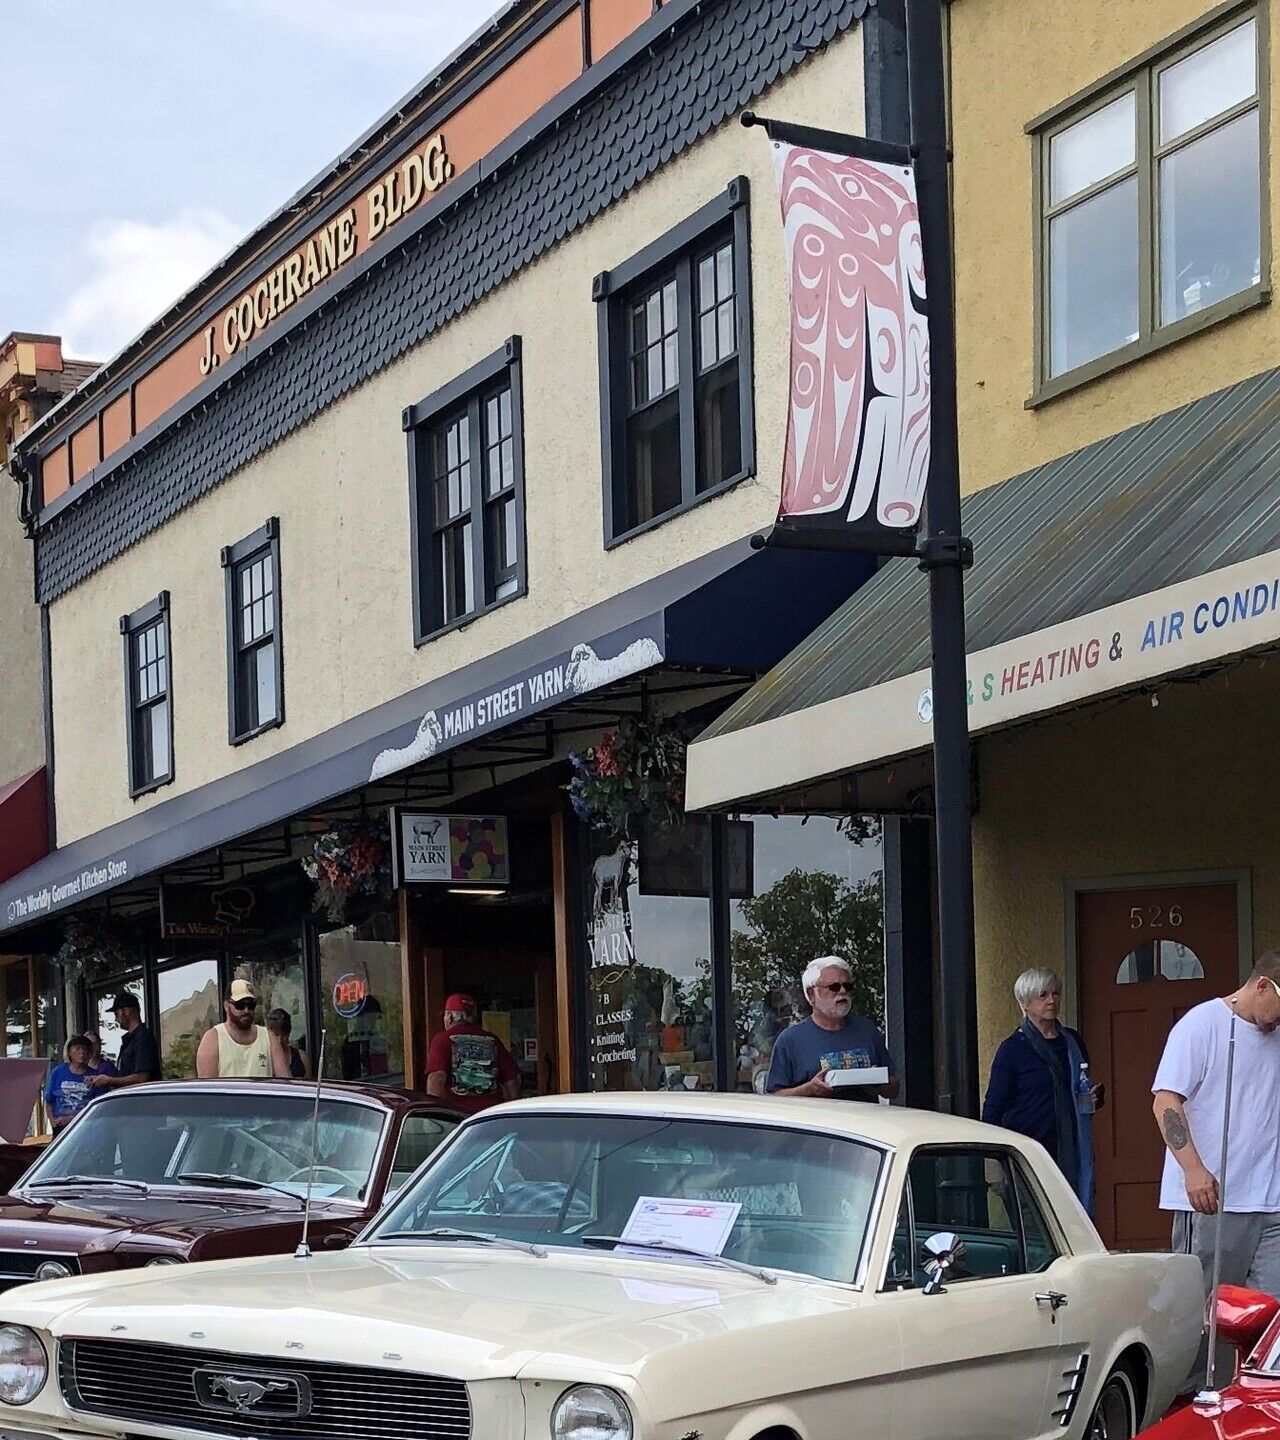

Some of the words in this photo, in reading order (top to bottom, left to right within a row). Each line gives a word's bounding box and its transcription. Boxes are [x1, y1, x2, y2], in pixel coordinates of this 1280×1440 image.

[200, 326, 220, 375] J.
[223, 208, 358, 355] COCHRANE
[368, 134, 454, 241] BLDG.
[981, 672, 995, 702] S
[1000, 638, 1101, 696] HEATING
[1109, 631, 1123, 662] &
[1140, 610, 1183, 652] AIR
[444, 711, 475, 740] MAIN
[477, 682, 525, 727] STREET
[528, 665, 565, 704] YARN
[409, 851, 447, 864] YARN
[15, 899, 28, 917] The
[26, 887, 52, 912] Worldly
[52, 877, 81, 904] Gourmet
[81, 866, 106, 892] Kitchen
[107, 859, 128, 883] Store
[1130, 904, 1183, 929] 526
[587, 928, 635, 968] YARN
[335, 979, 366, 1006] OPEN
[596, 1008, 634, 1026] CLASSES:
